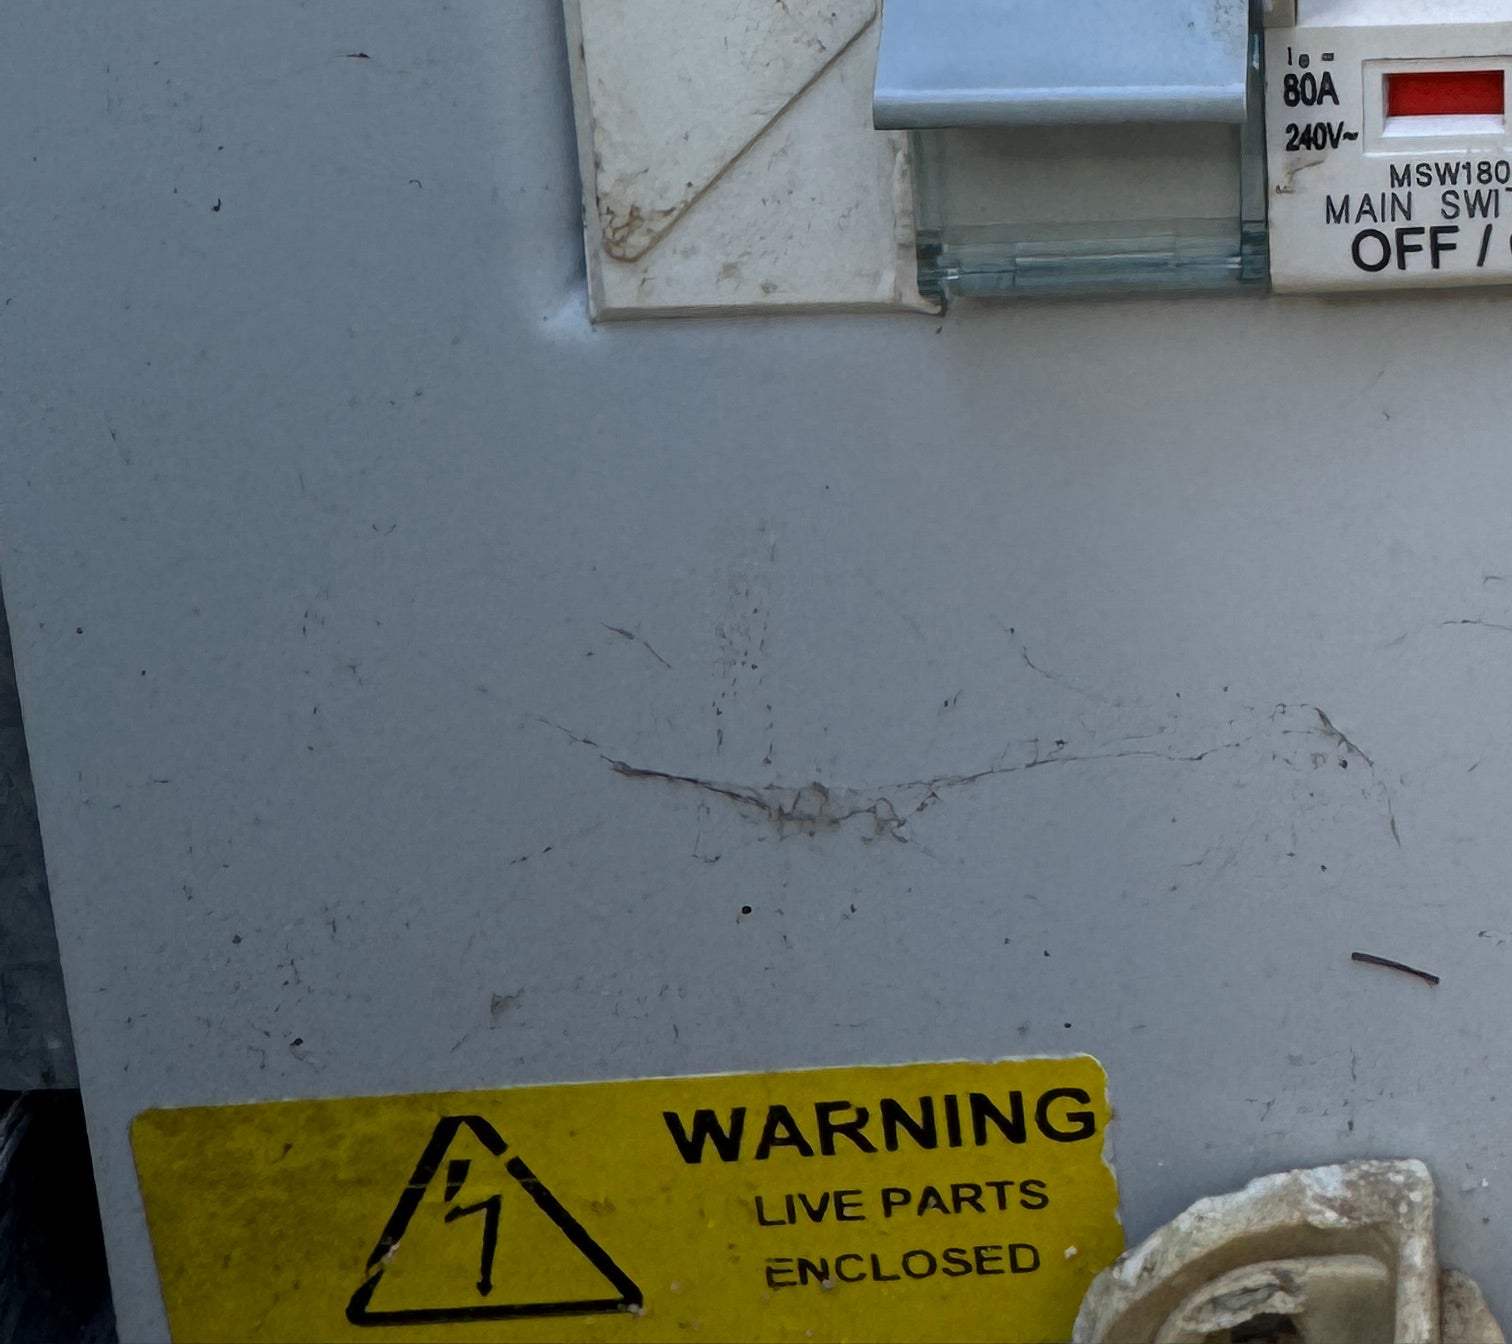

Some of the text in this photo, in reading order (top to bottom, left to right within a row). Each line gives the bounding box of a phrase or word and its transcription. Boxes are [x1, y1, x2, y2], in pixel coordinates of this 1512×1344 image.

[1283, 71, 1340, 107] 80A
[1390, 160, 1511, 188] MSW180
[1325, 192, 1412, 224] MAIN
[662, 1087, 1097, 1165] WARNING
[754, 1179, 1050, 1226] LIVE PARTS
[765, 1242, 1041, 1290] ENCLOSED
